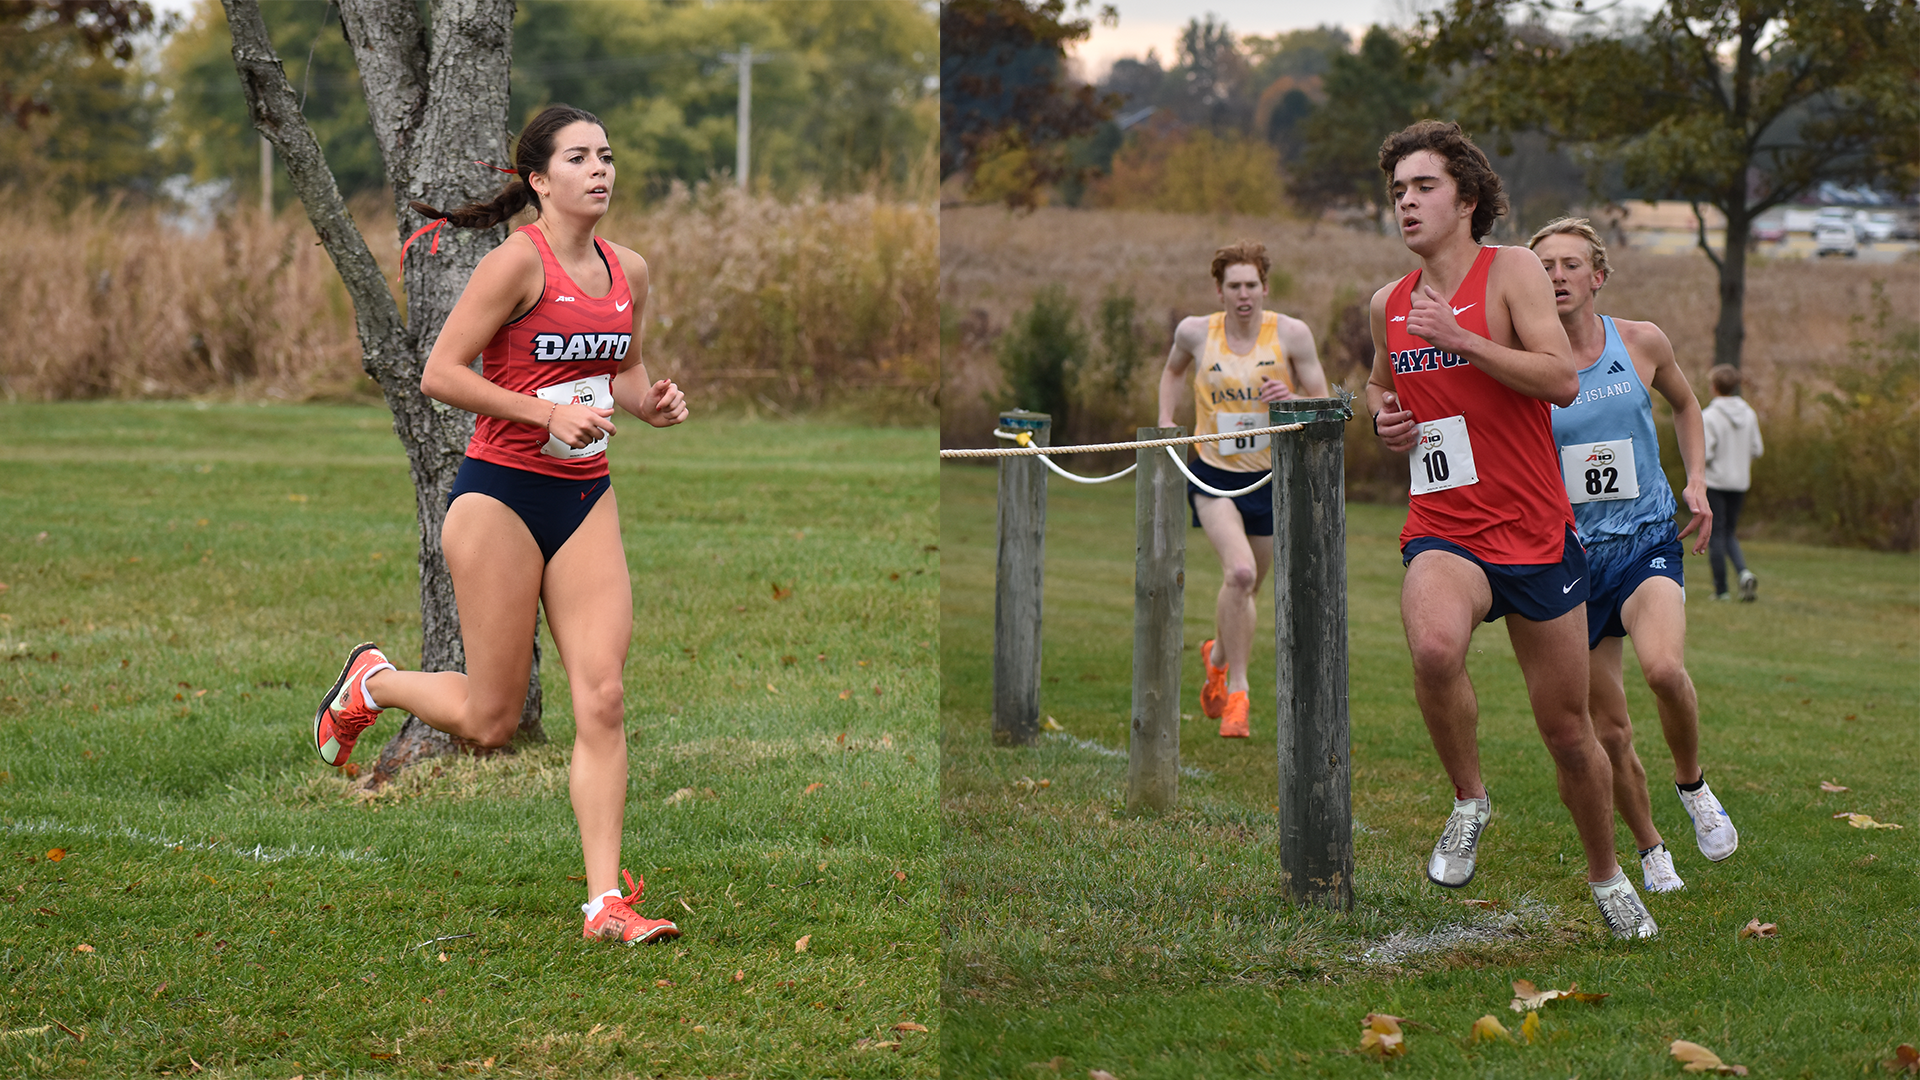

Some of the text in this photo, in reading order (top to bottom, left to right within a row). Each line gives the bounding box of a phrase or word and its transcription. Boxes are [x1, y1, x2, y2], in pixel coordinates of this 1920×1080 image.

[1211, 387, 1262, 405] LASAL
[1585, 381, 1632, 403] ISLAND
[1419, 434, 1441, 446] A10
[1422, 450, 1450, 484] 10
[1585, 454, 1612, 463] A10
[1584, 467, 1619, 495] 82
